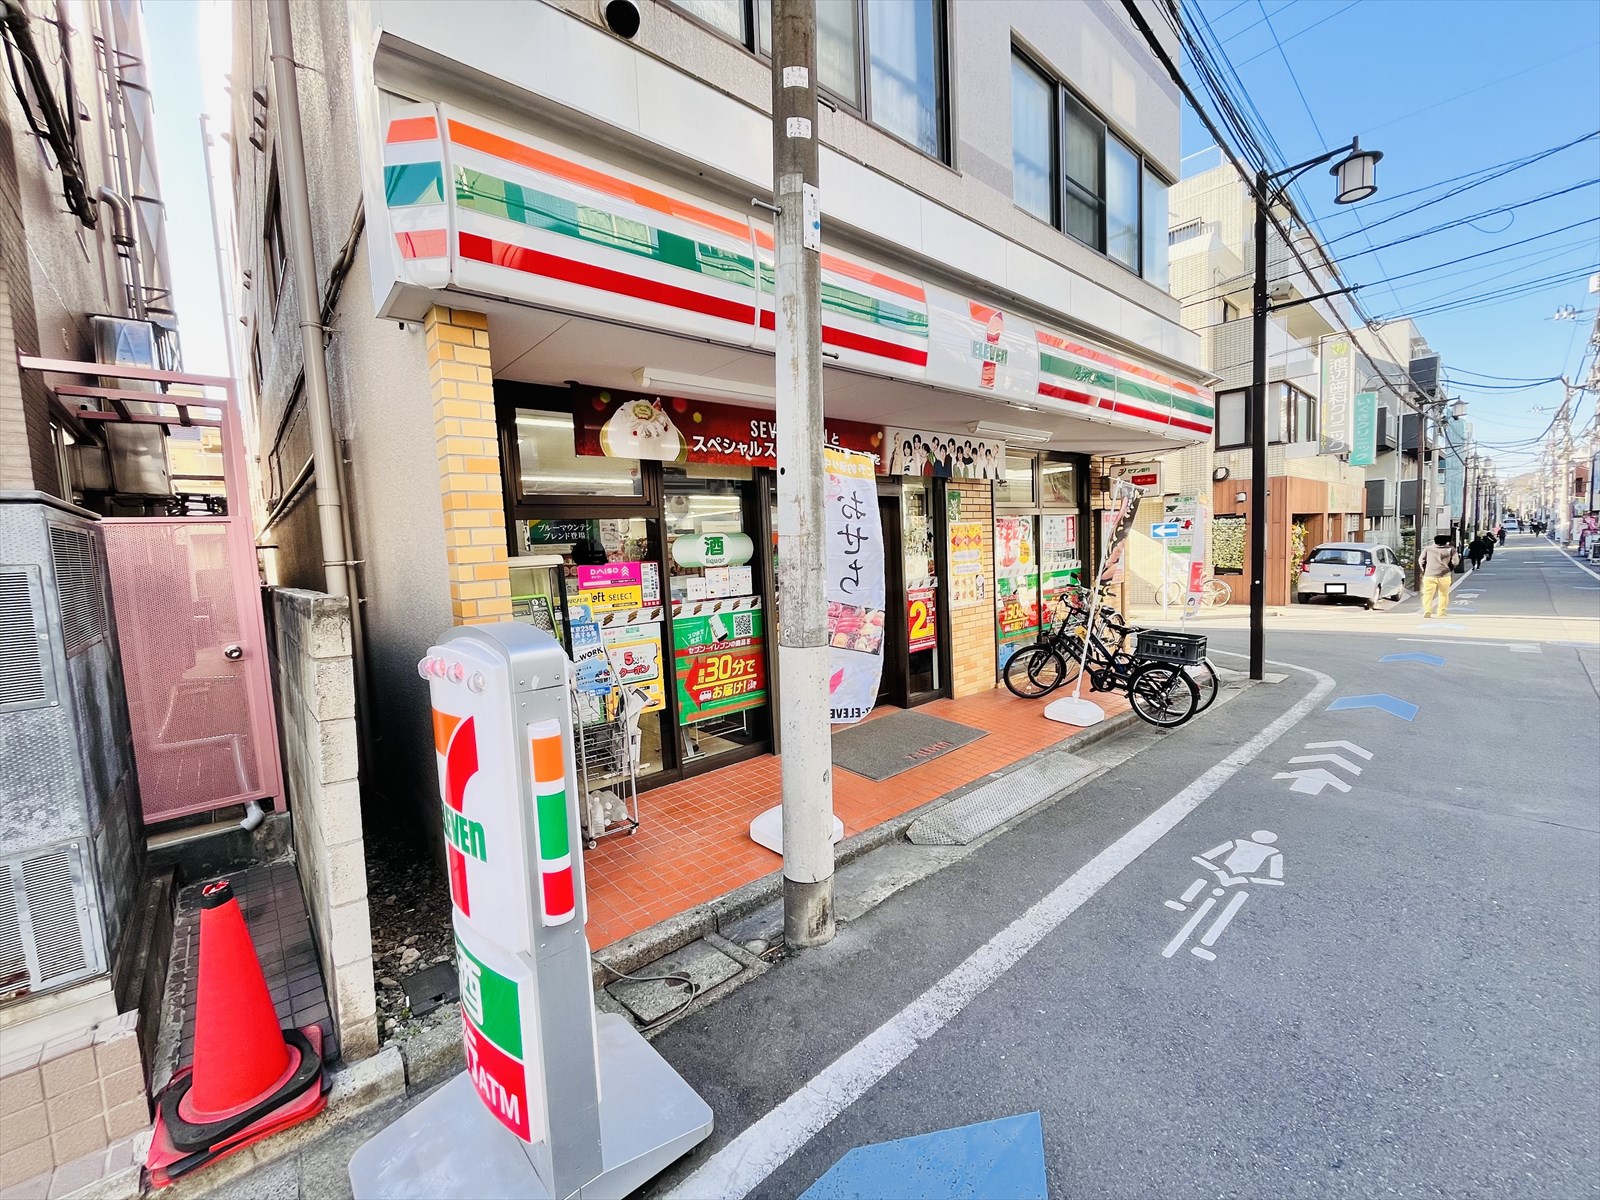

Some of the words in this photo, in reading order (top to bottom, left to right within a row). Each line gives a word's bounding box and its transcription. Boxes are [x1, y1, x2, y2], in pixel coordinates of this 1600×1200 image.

[705, 536, 725, 557] 酒
[705, 557, 726, 566] liquor
[590, 567, 619, 576] DAISO
[608, 592, 633, 602] SELECT
[579, 646, 604, 661] WORK
[479, 1065, 521, 1126] ATM
